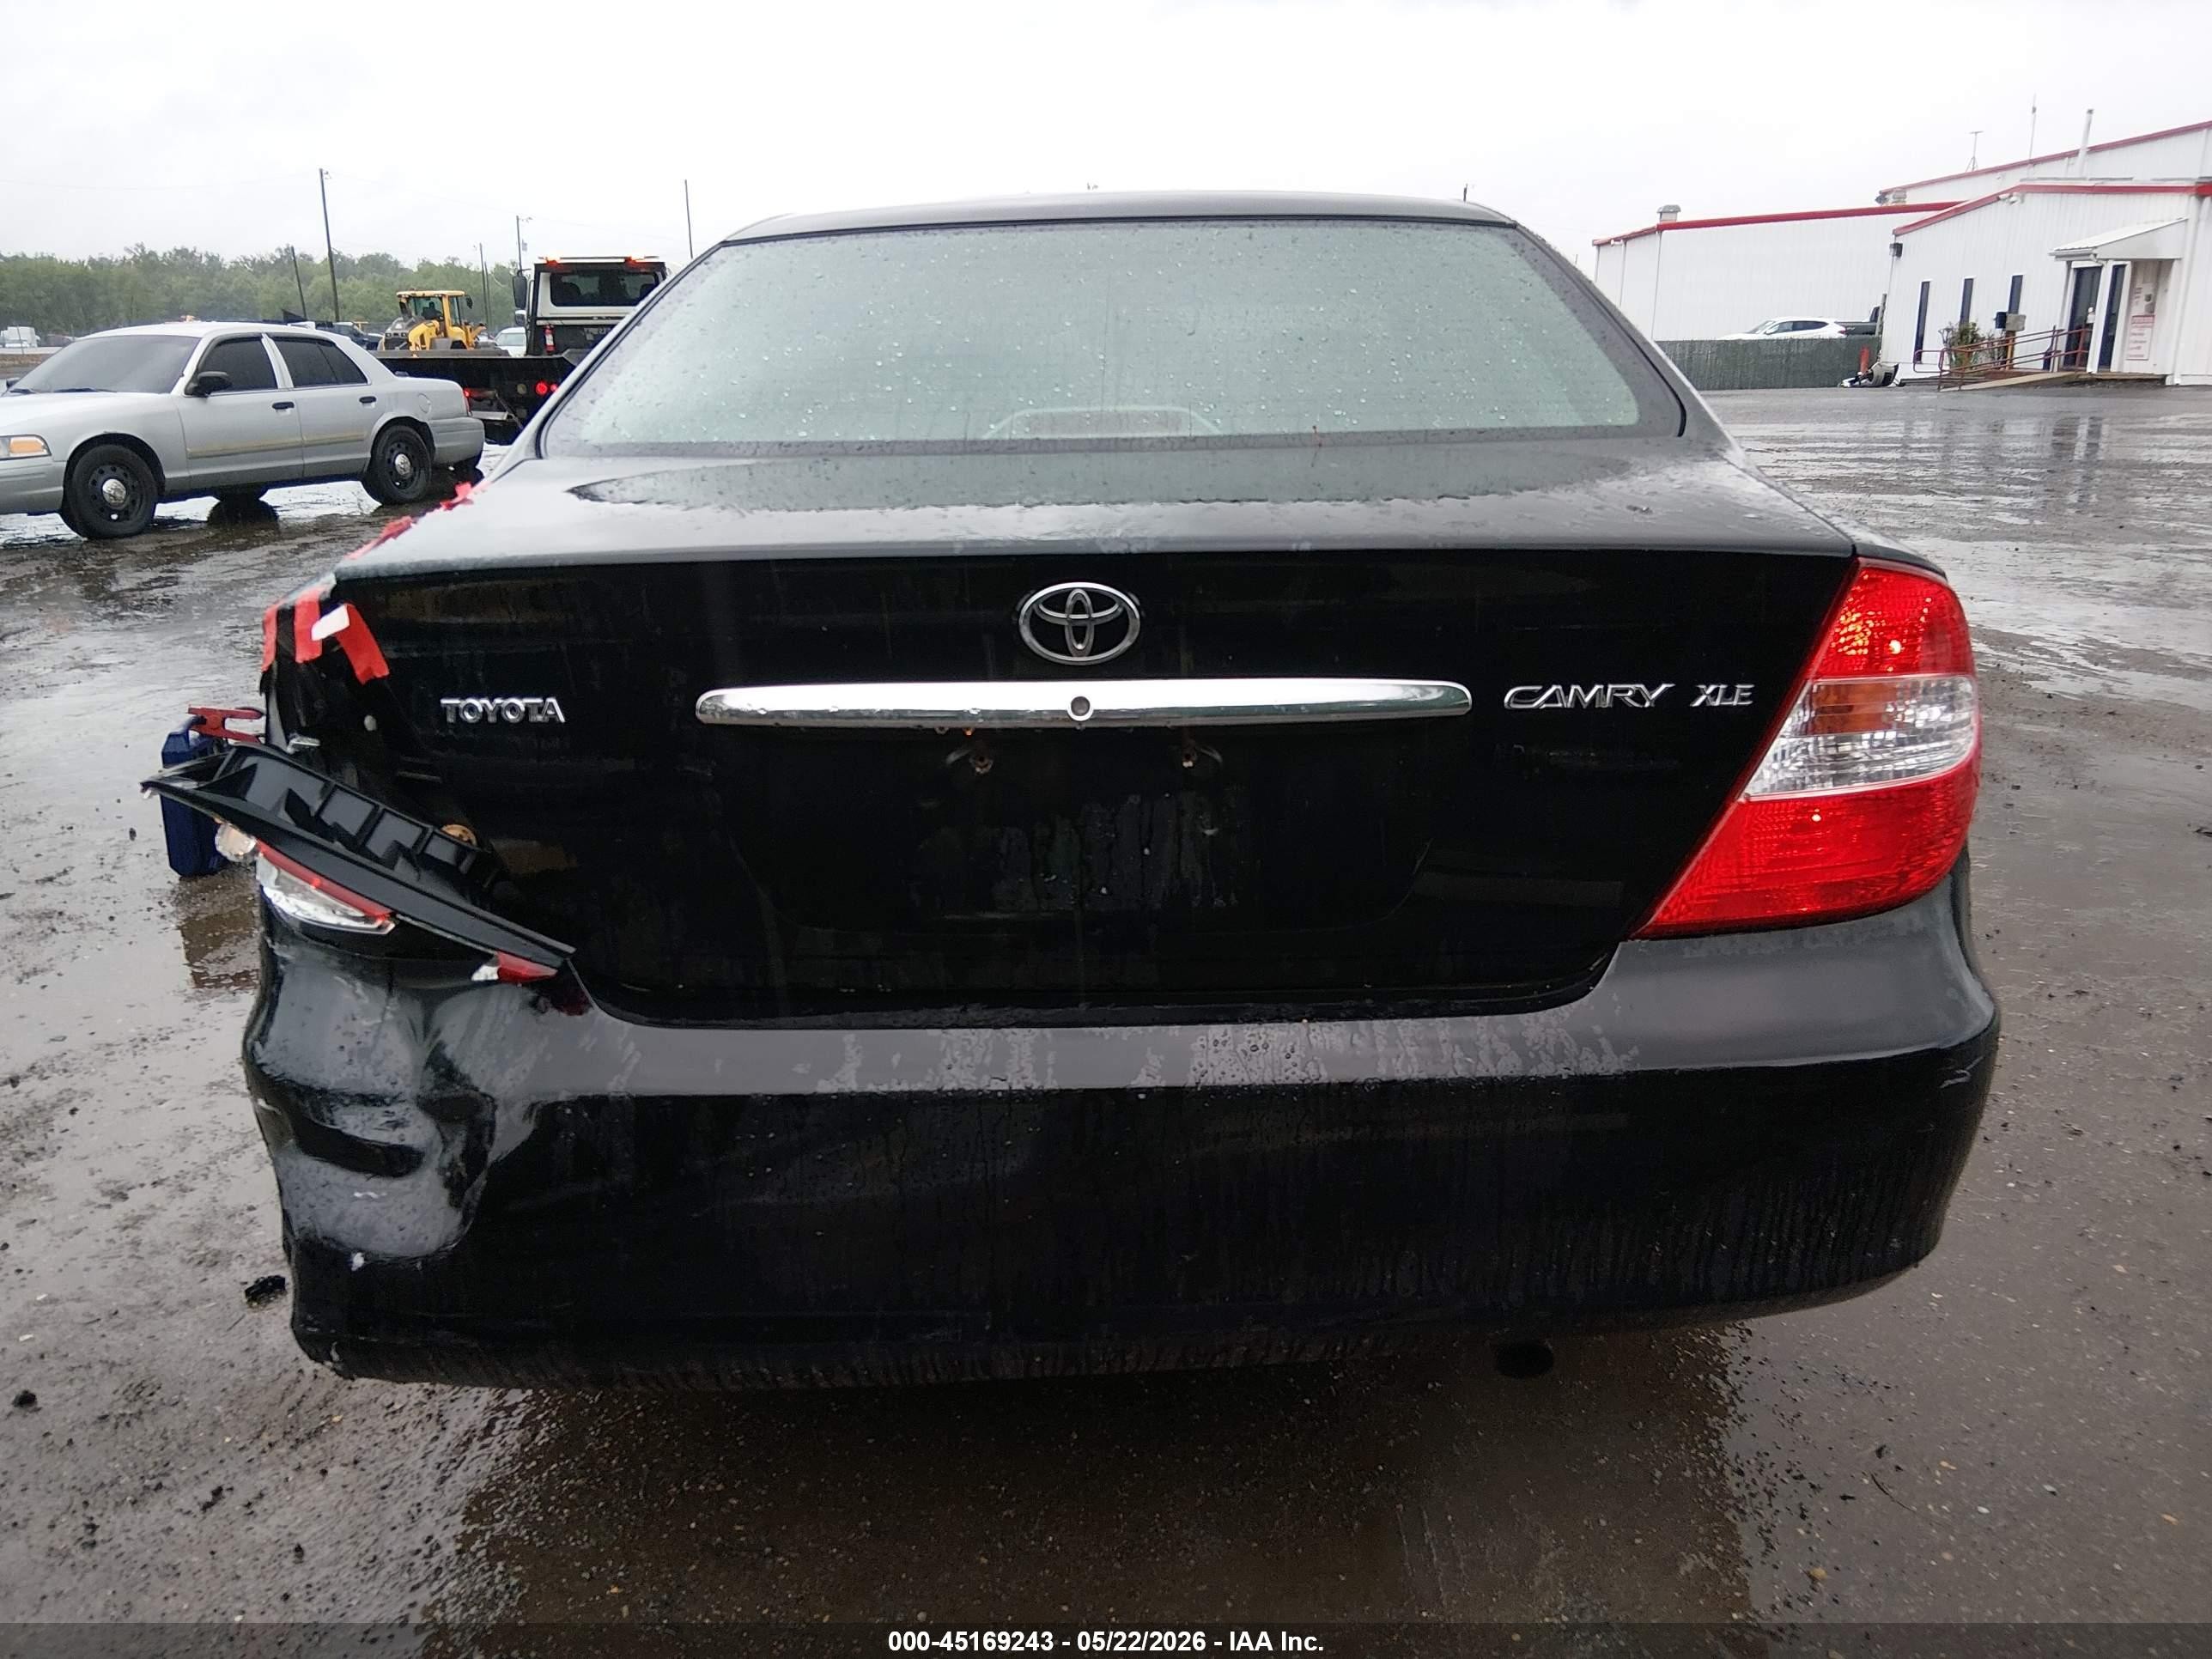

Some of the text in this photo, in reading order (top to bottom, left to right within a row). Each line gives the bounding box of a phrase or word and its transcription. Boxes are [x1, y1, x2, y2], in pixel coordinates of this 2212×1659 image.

[440, 696, 566, 723] TOYOTA
[1504, 684, 1754, 709] CAMRY XLE
